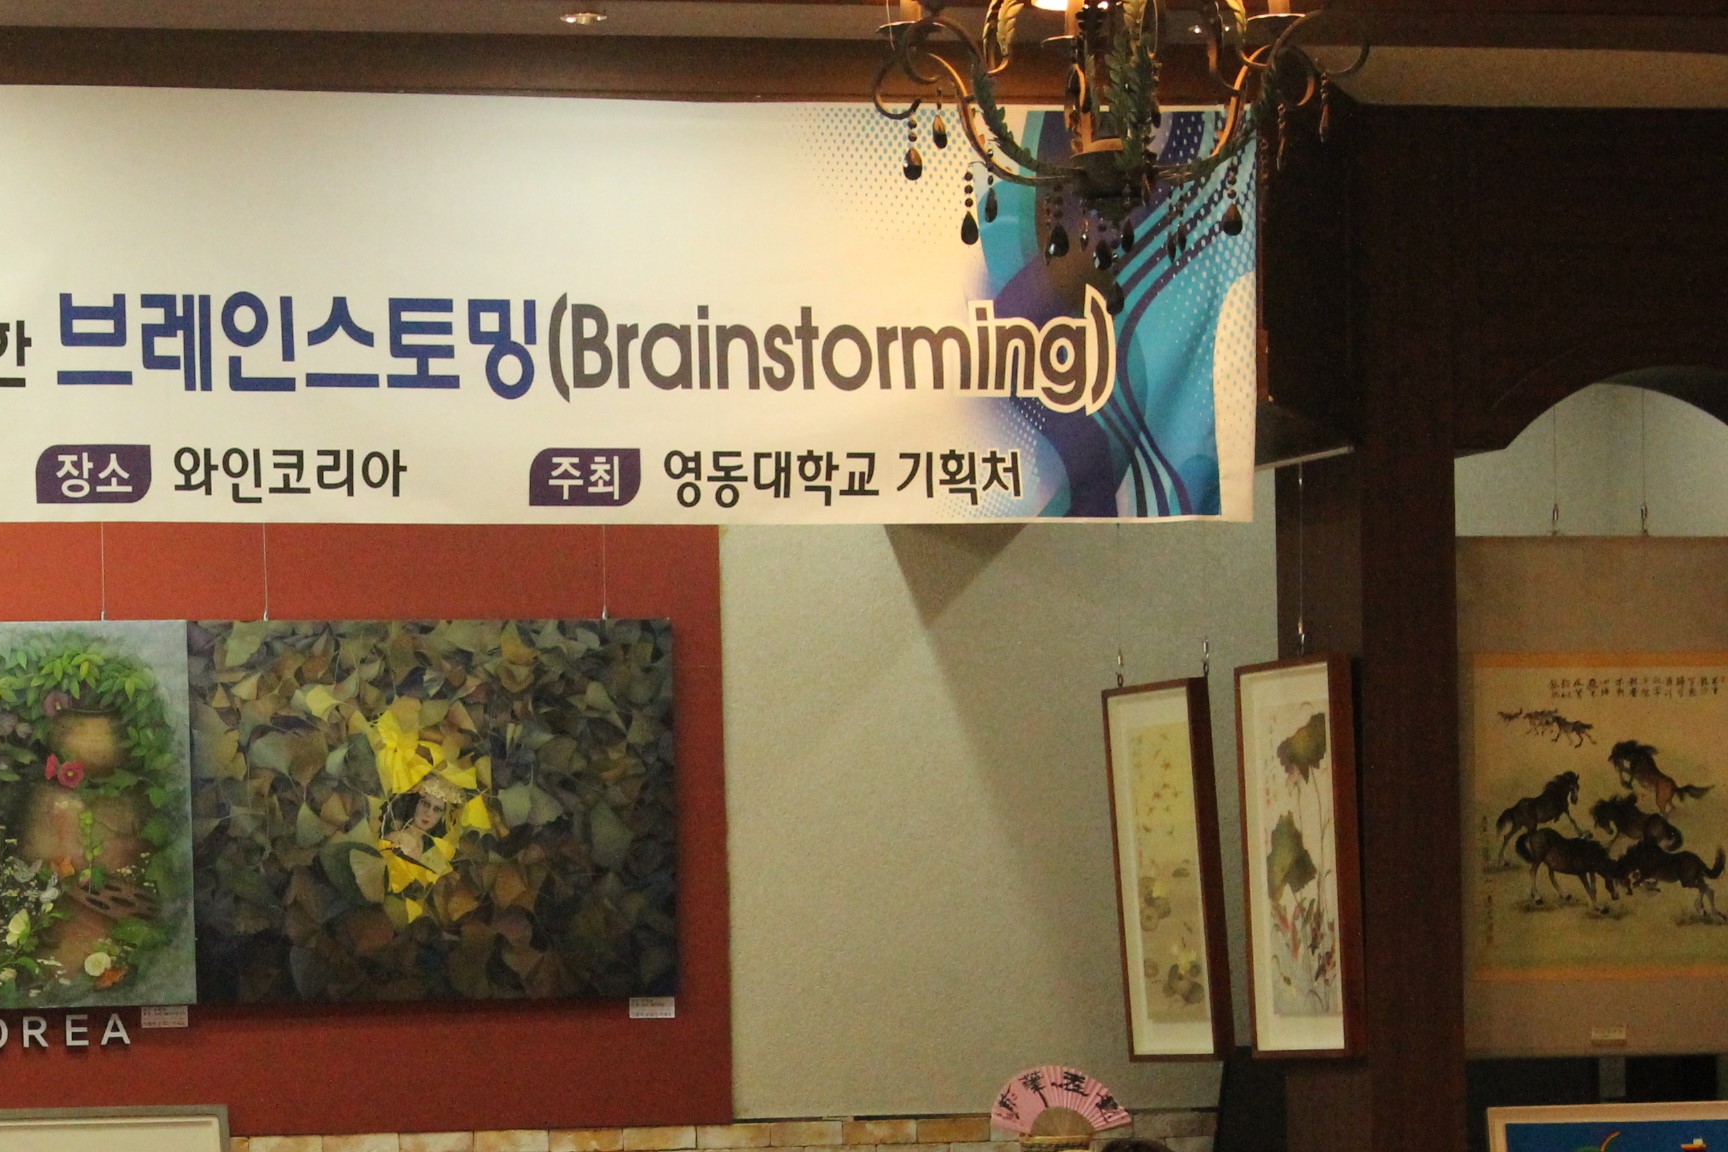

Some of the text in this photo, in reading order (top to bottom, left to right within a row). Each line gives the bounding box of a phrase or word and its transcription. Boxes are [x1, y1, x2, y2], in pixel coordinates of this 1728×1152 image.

[57, 290, 1110, 410] 브레인스토밍(Brainstorming)
[56, 446, 407, 504] 장소 와인코리아
[547, 448, 1022, 509] 주최 영동대학교 기획처
